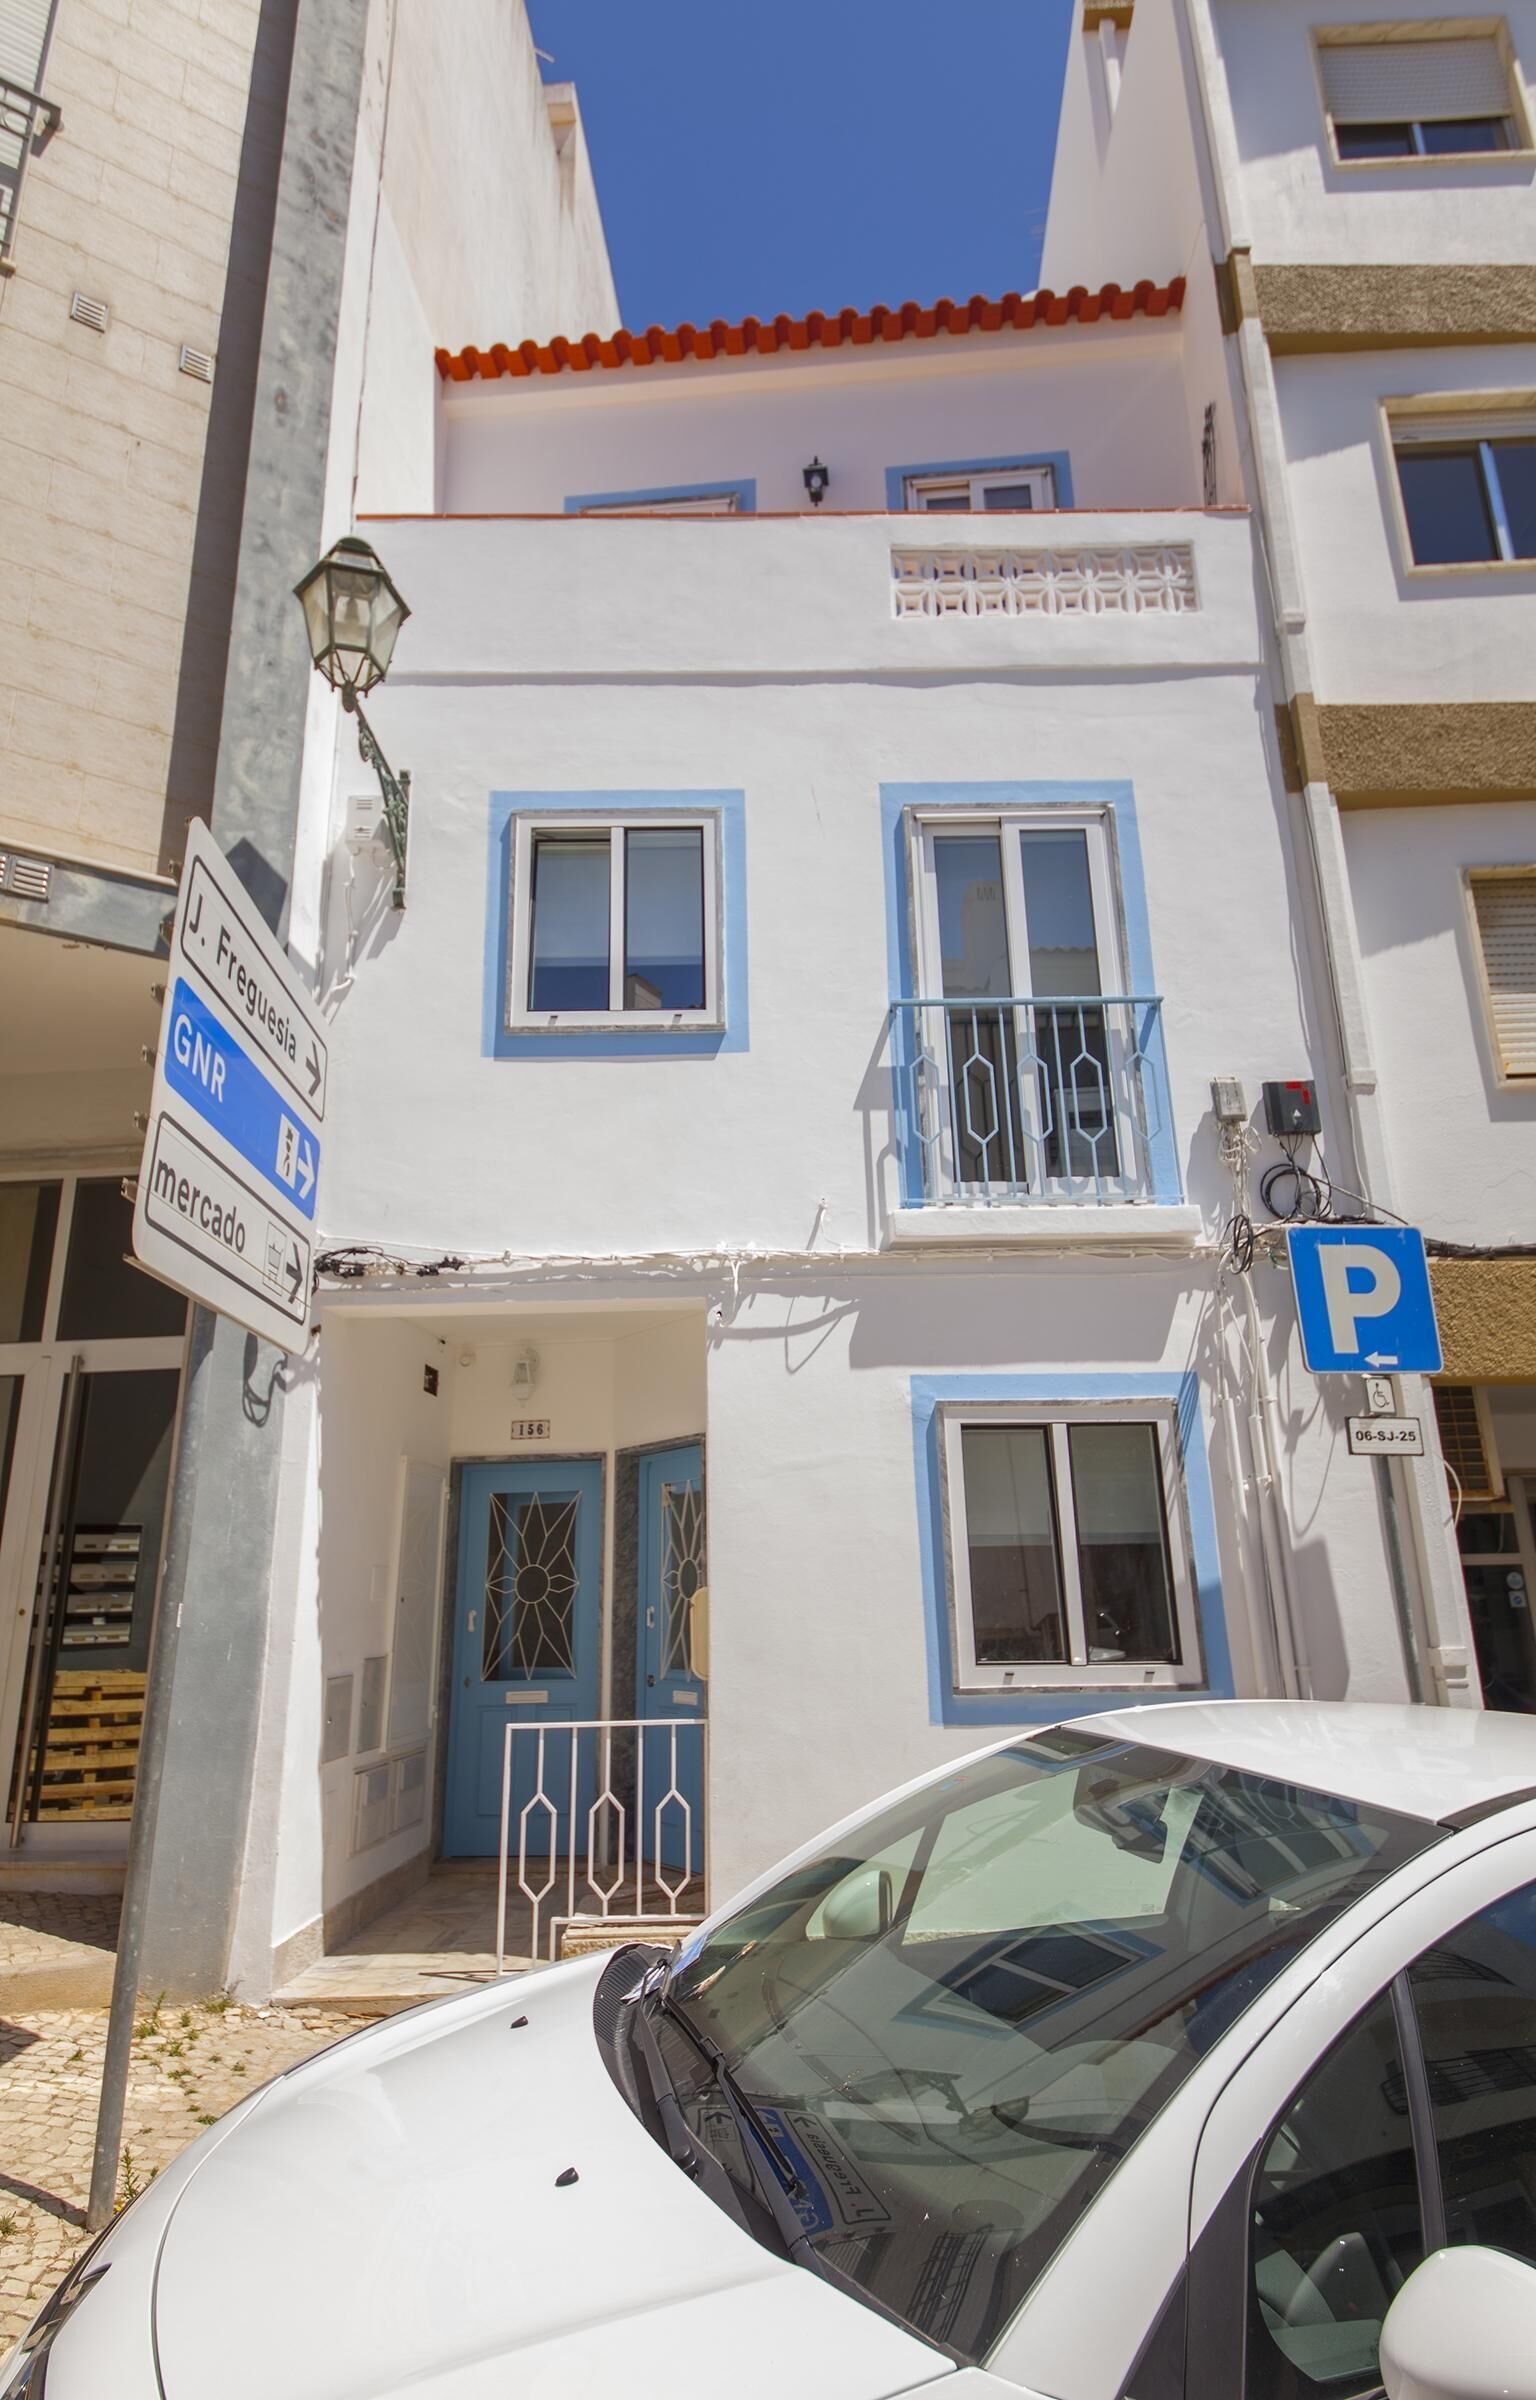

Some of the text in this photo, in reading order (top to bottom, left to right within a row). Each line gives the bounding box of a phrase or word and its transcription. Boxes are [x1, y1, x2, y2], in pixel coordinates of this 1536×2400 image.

[188, 893, 297, 1063] J. Freguesia
[173, 1013, 227, 1104] GNR
[154, 1157, 247, 1255] mercado
[1318, 1243, 1402, 1354] P
[519, 1423, 544, 1436] 156
[1355, 1430, 1417, 1442] 06-SJ-25
